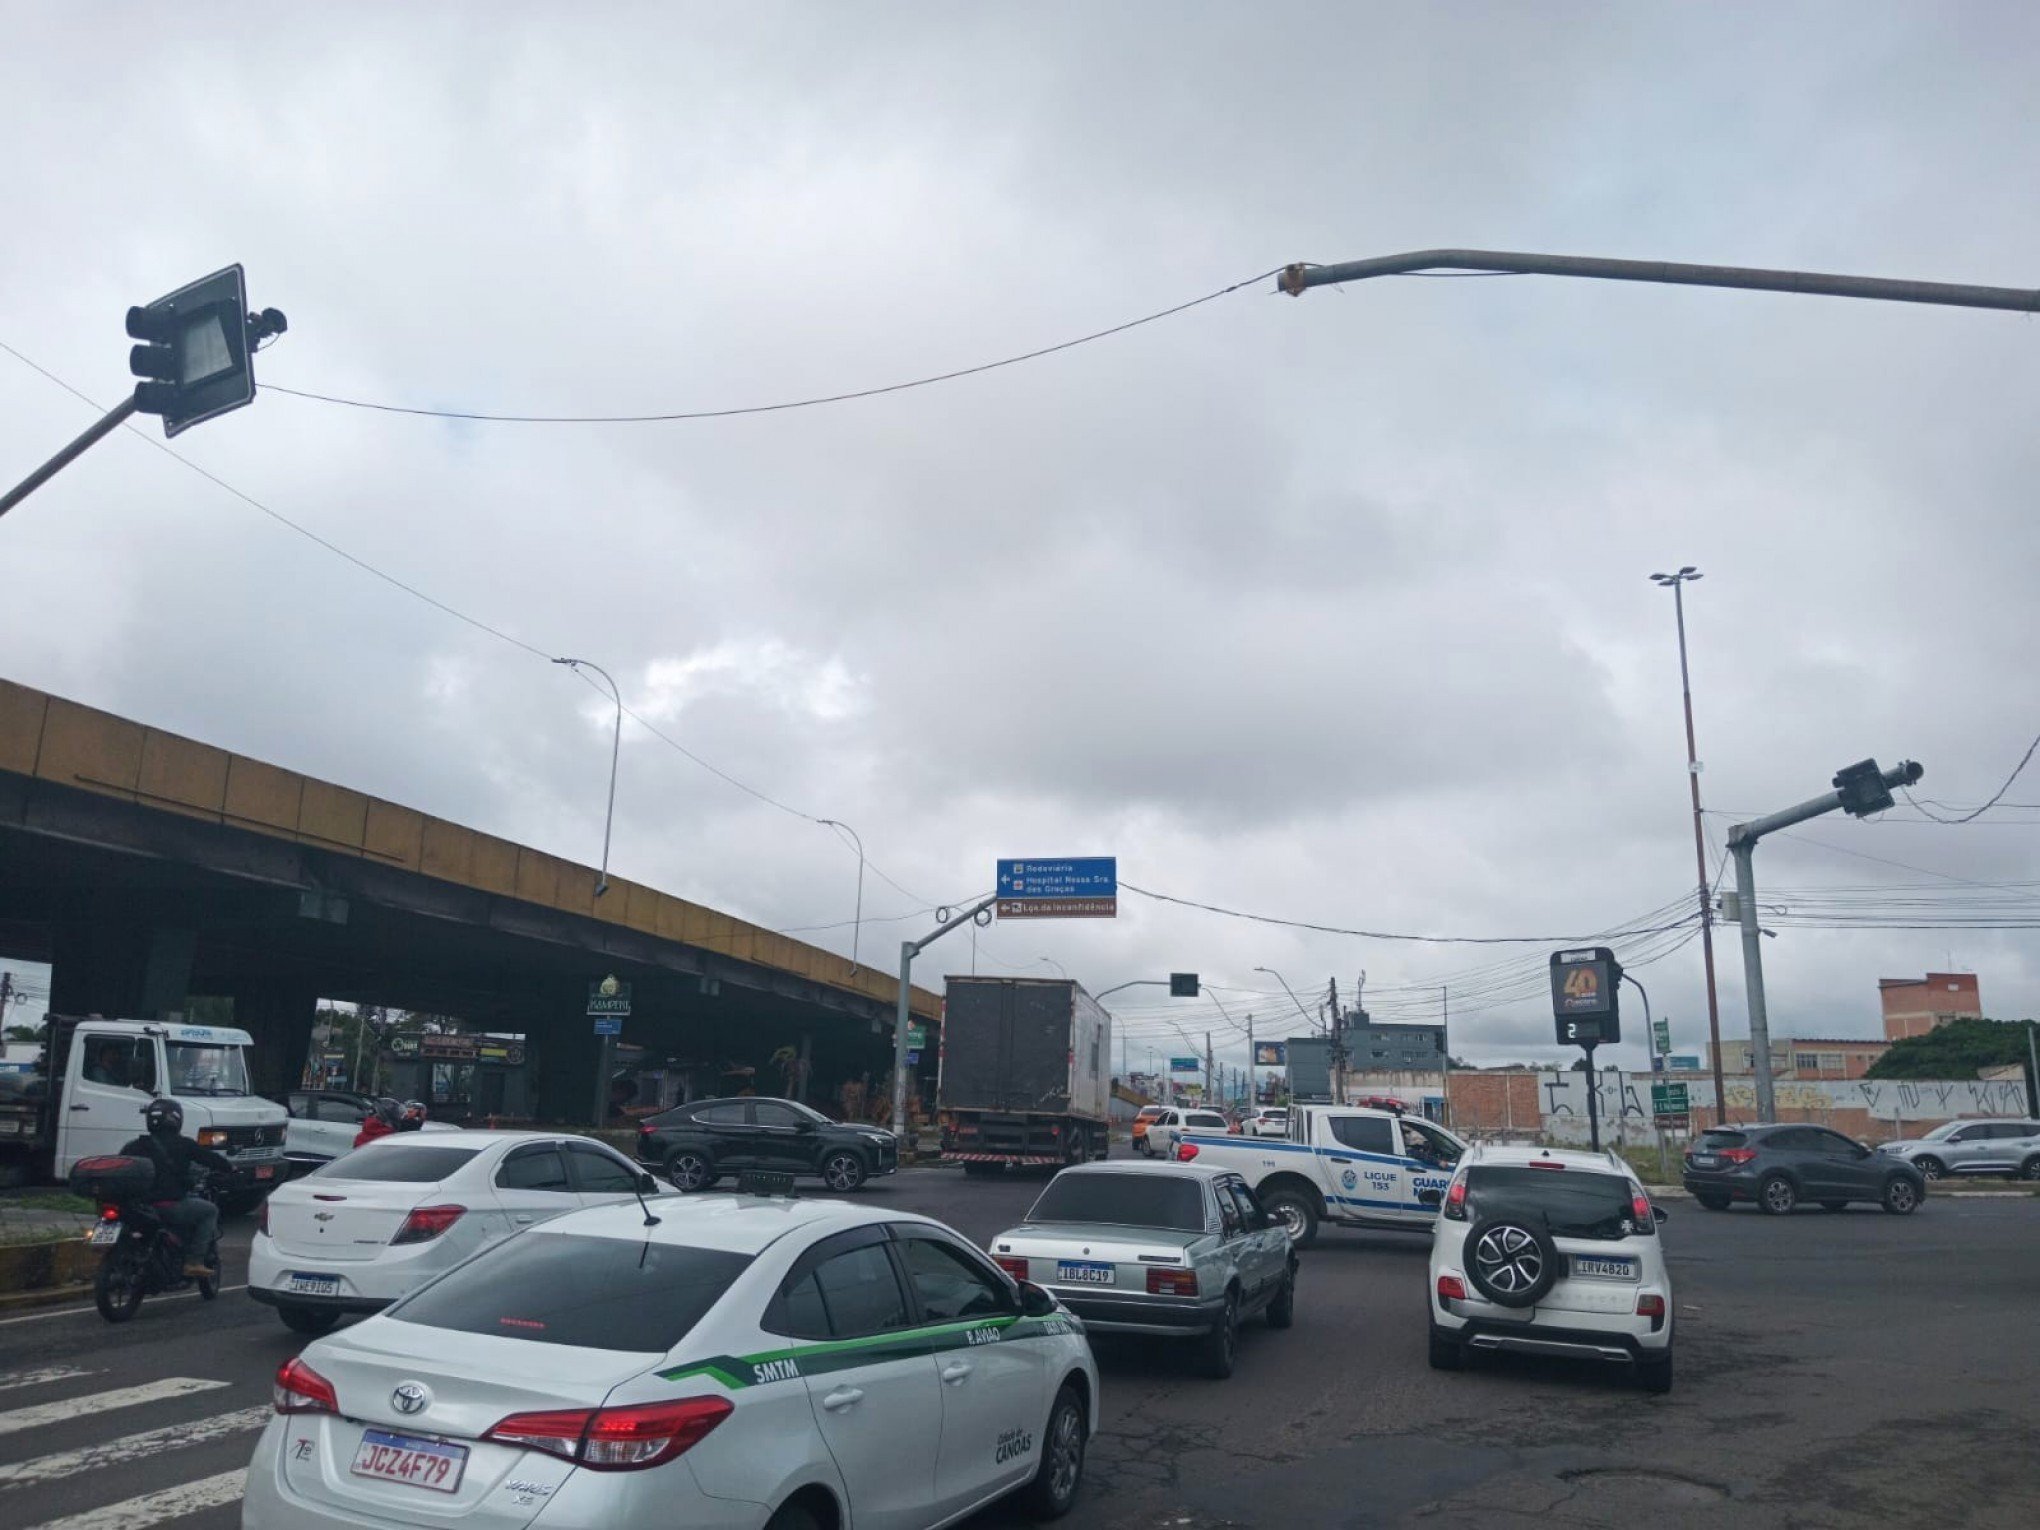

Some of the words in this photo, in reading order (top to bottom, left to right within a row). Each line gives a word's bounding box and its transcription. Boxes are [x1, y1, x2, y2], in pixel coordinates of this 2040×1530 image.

[1026, 864, 1073, 873] Rodoviária
[1026, 876, 1062, 885] Hospital
[1044, 885, 1075, 894] Graças
[1052, 902, 1114, 911] Inconfidência
[1364, 1171, 1397, 1182] LIGUE
[1372, 1182, 1390, 1192] 153
[754, 1358, 799, 1383] SMTM
[996, 1434, 1031, 1465] CANOAS
[361, 1445, 452, 1484] JCZ4F79
